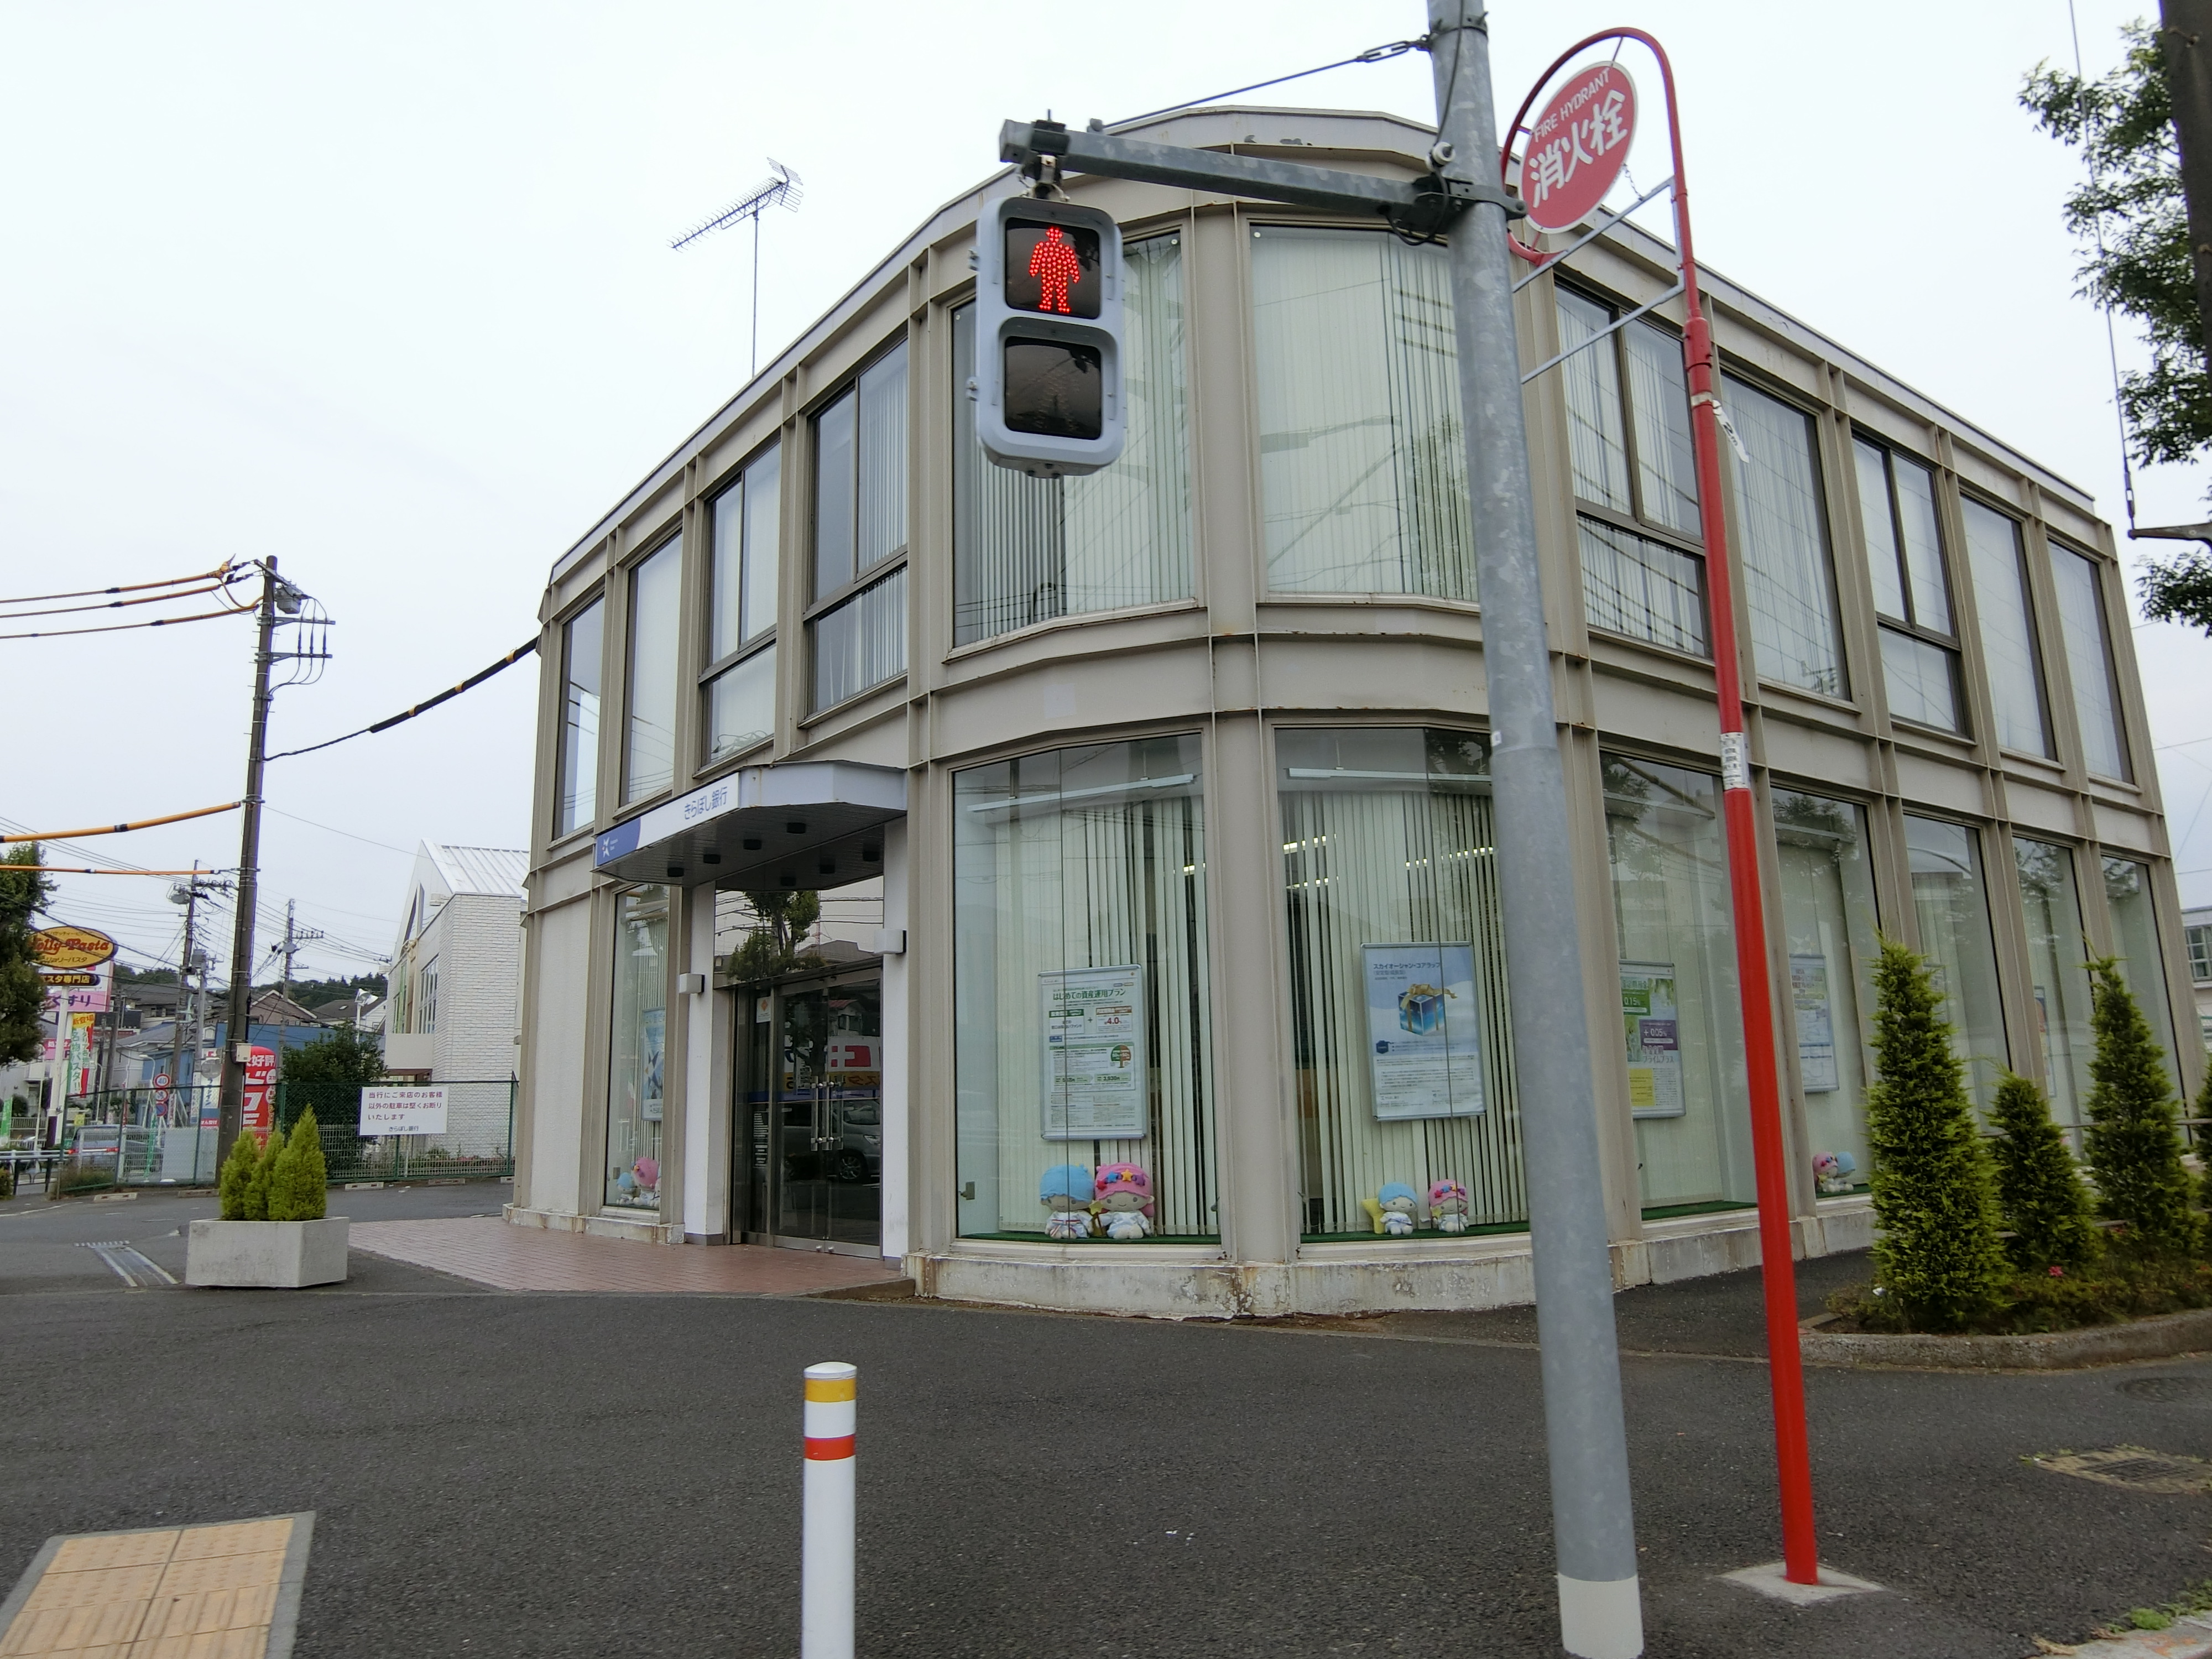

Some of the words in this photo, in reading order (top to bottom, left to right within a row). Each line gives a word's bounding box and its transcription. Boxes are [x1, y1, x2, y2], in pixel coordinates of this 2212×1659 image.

[1533, 113, 1558, 143] FIRE
[1559, 67, 1610, 121] HYDRANT
[1528, 89, 1628, 208] 消火栓
[684, 786, 728, 820] きらぼし銀行
